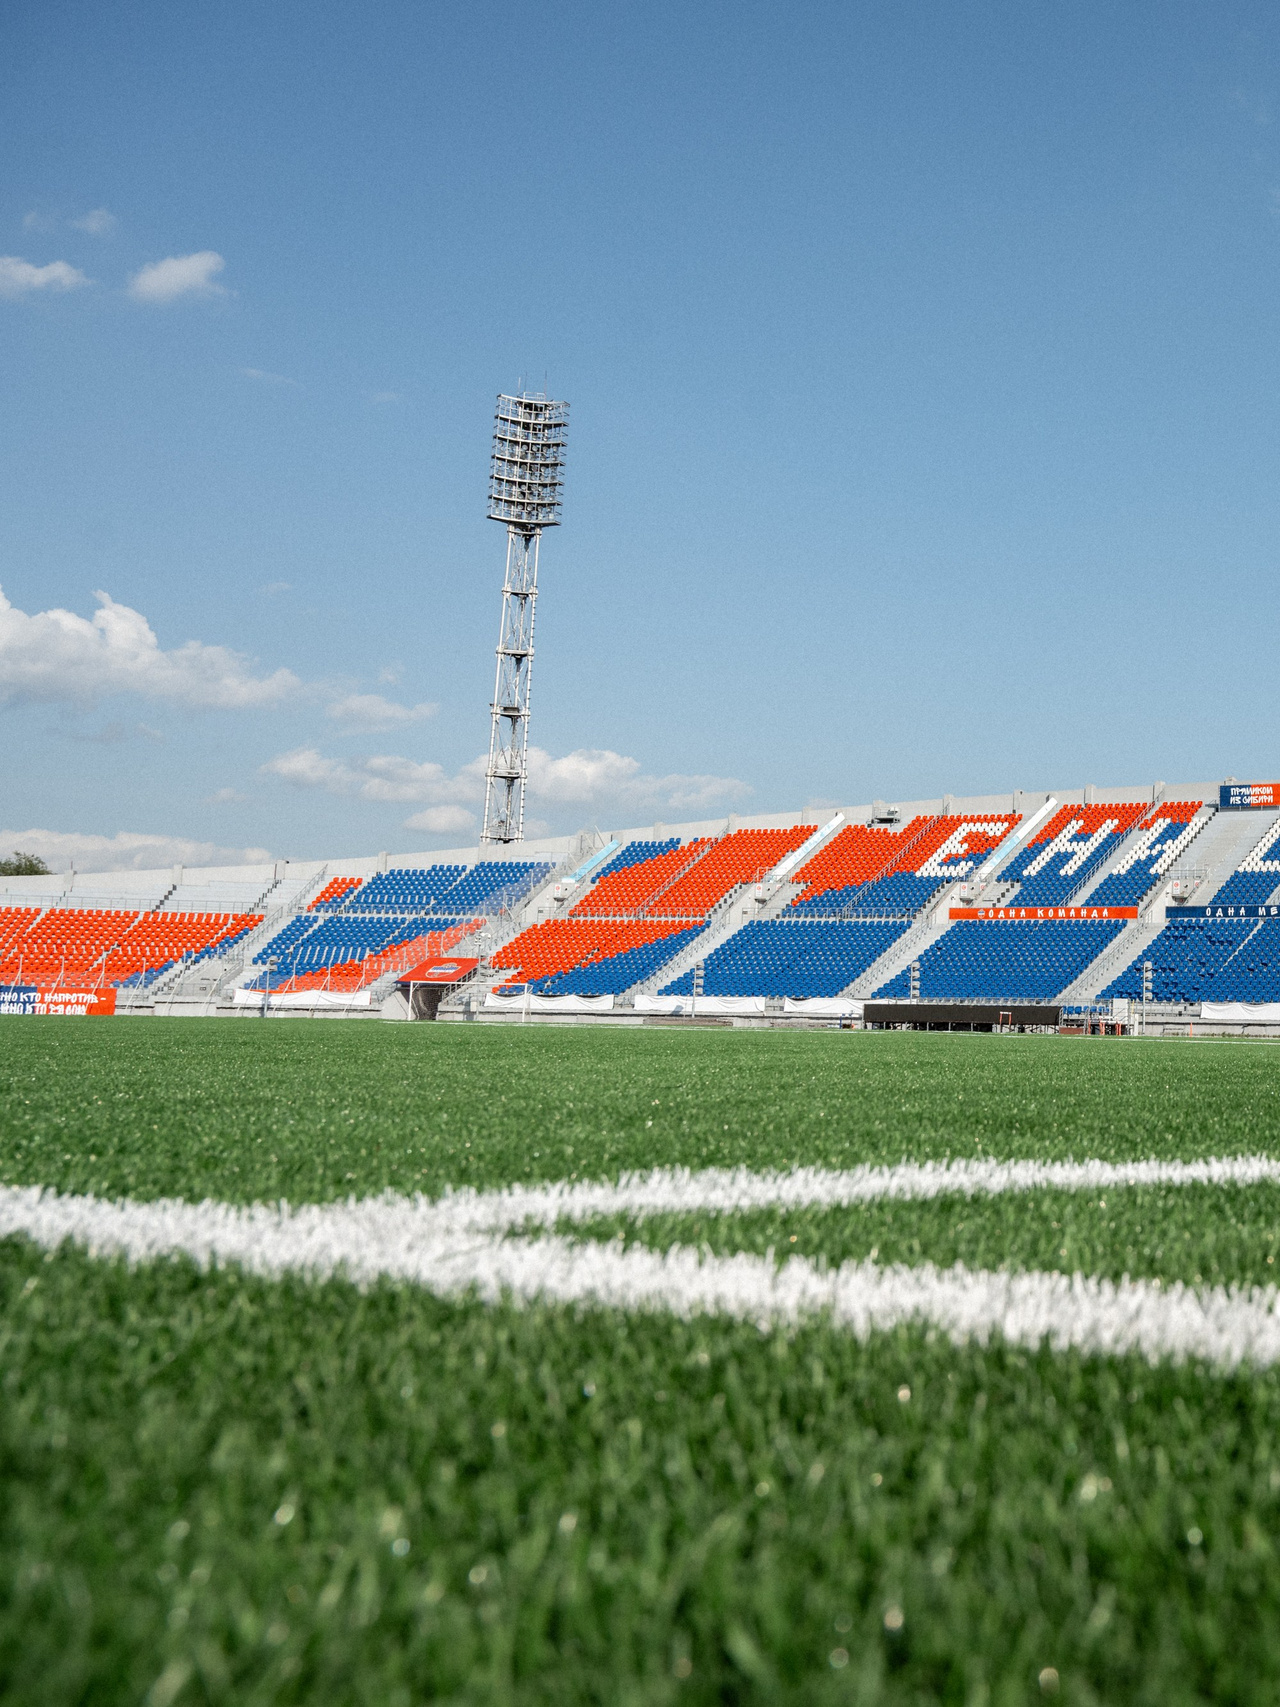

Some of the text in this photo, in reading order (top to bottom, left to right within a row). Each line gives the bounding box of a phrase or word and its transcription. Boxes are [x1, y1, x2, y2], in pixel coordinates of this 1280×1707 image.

[1230, 786, 1273, 796] ПРЯМИКОМ
[1229, 795, 1273, 805] ИЗ СИБИРИ
[988, 908, 1109, 918] ОДНА КОМАНДА
[1205, 907, 1246, 917] ОДНА
[20, 992, 41, 1003] КТО
[44, 992, 98, 1004] НАПРОТИВ
[25, 1003, 47, 1015] КТО
